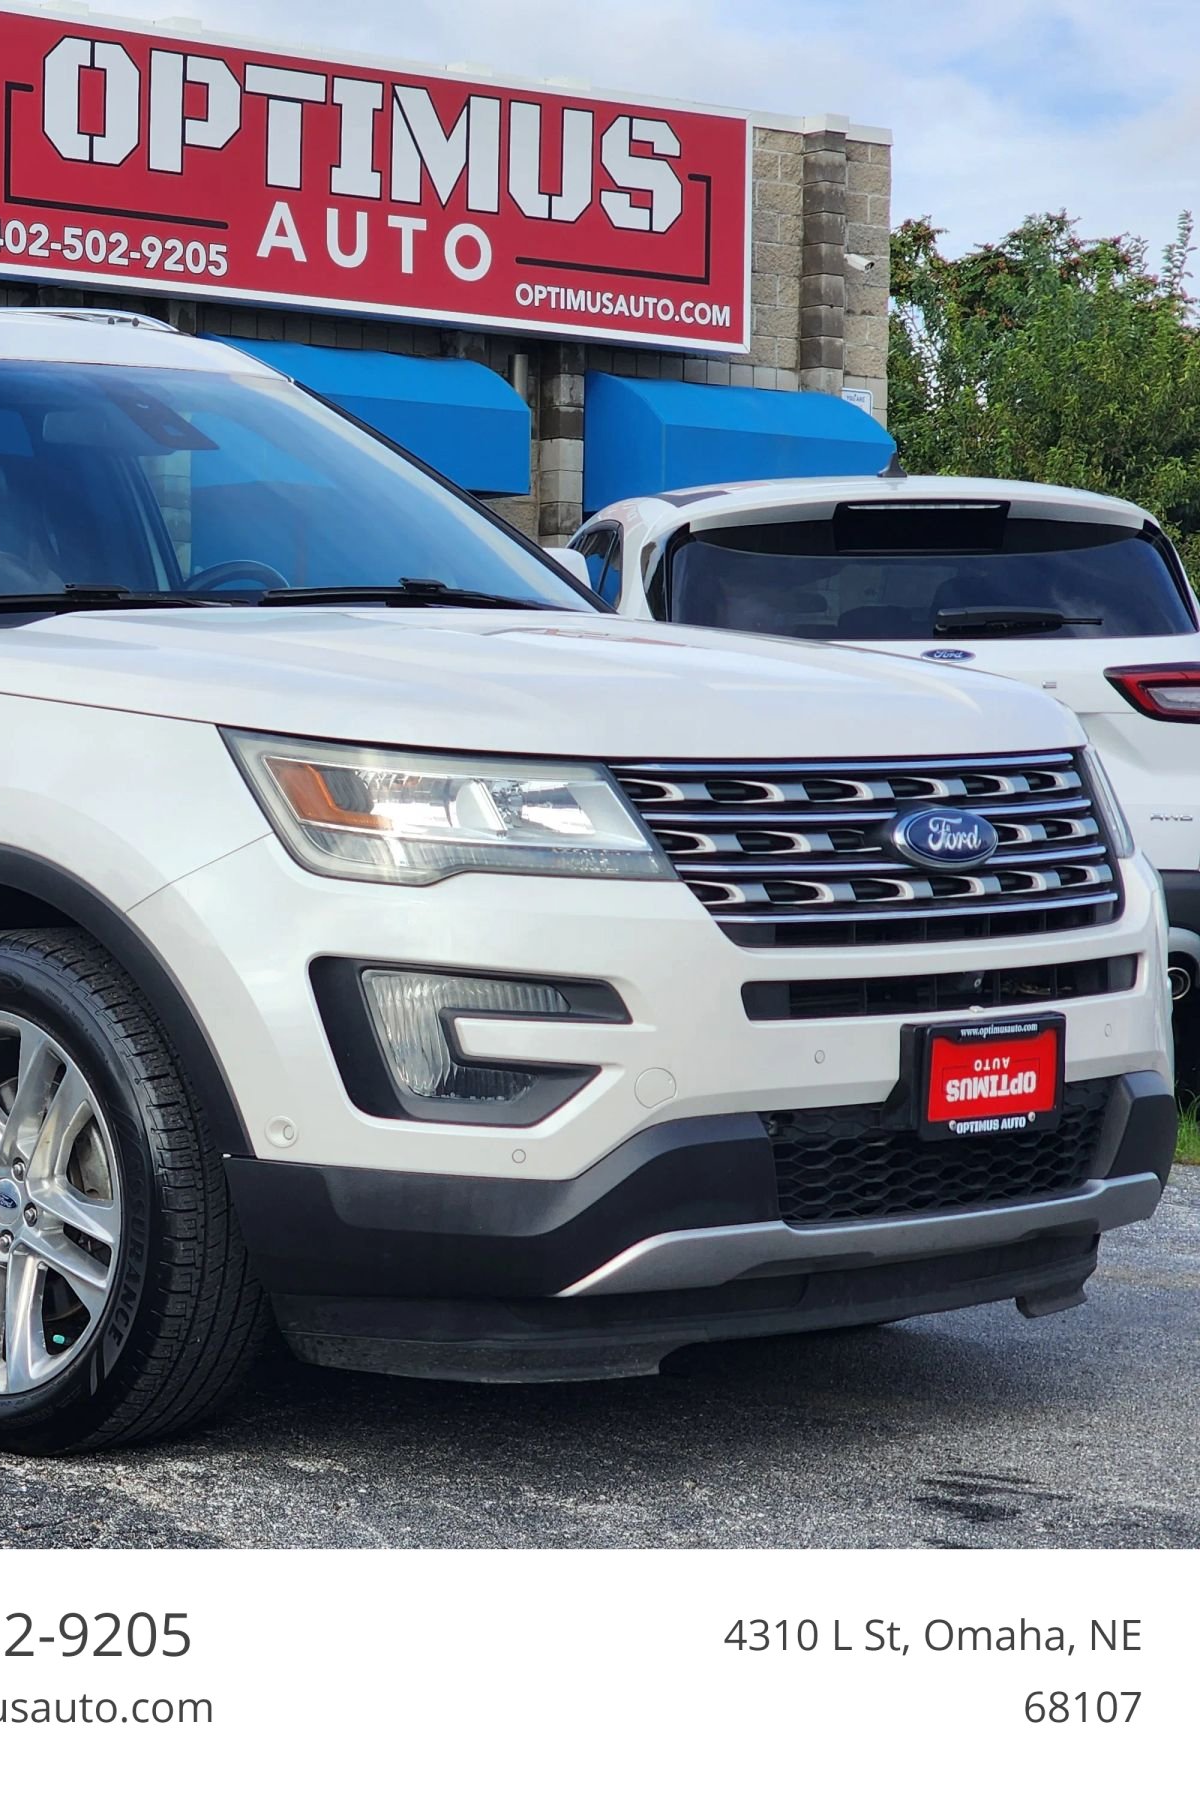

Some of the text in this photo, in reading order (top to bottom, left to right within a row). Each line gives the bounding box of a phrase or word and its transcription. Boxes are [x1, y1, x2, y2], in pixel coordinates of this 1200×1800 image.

[42, 35, 684, 234] OPTIMUS
[256, 201, 493, 282] AUTO
[515, 283, 732, 328] OPTIMUSAUTO.COM
[928, 816, 982, 851] Ford
[960, 1022, 1038, 1038] www.optimusauto.com
[974, 1056, 1010, 1072] AUTO
[946, 1071, 1037, 1102] OPTIMUS
[956, 1116, 1026, 1134] OPTIMUS AUTO
